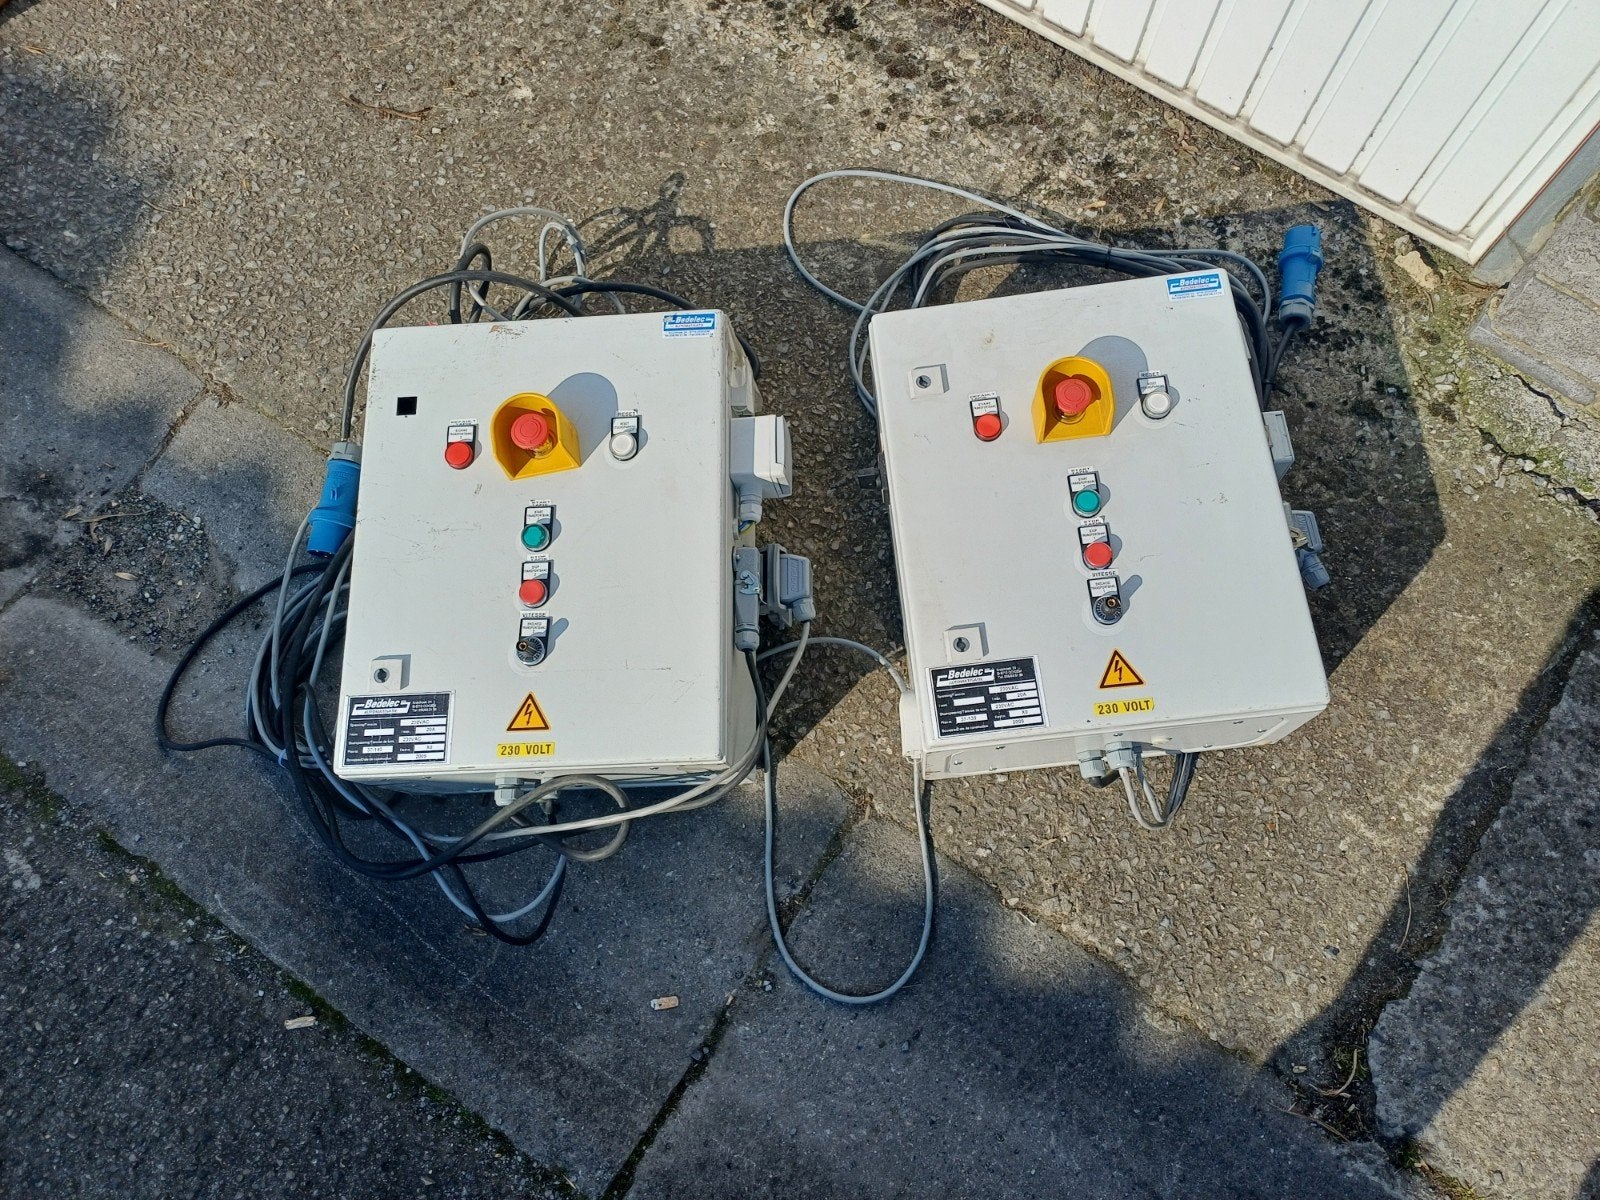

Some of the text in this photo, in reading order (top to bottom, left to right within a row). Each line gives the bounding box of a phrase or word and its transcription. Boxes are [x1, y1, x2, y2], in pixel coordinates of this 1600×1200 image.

[947, 667, 984, 680] Bedelec
[364, 698, 400, 709] Bedelec
[1098, 700, 1150, 715] 230 VOLT
[500, 744, 551, 756] 230 VOLT
